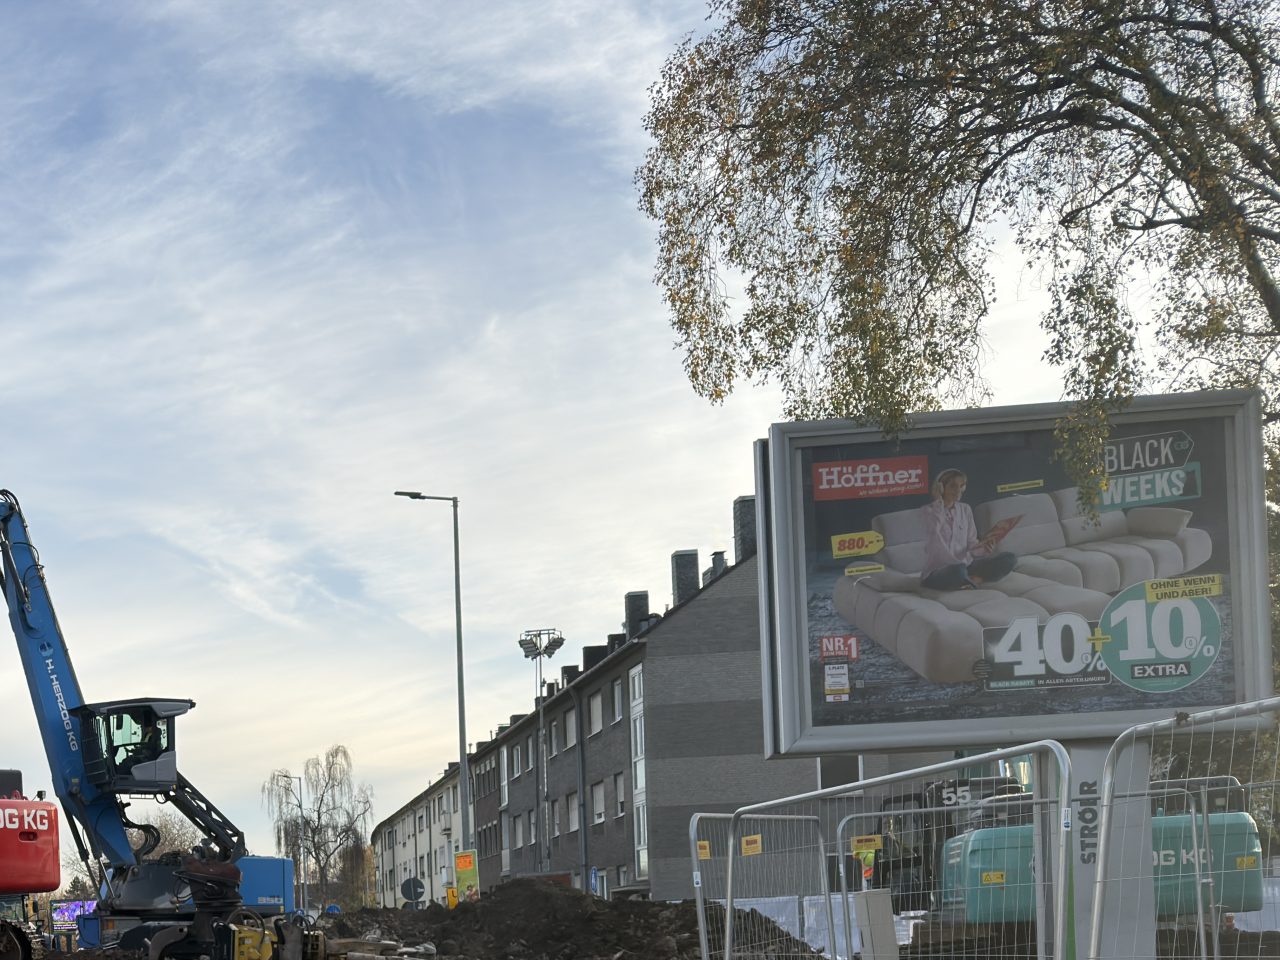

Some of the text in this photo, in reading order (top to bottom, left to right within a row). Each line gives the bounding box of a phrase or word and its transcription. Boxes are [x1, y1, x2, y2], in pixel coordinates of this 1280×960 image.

[1104, 437, 1175, 473] BLACK
[818, 464, 922, 489] Höffner
[1103, 470, 1186, 505] WEEKS
[1150, 576, 1215, 590] OHNE WENN
[1156, 587, 1212, 600] UND ABER!
[1134, 664, 1188, 677] EXTRA
[45, 659, 79, 751] H. HERZOG KG
[942, 786, 972, 805] 55
[23, 809, 49, 831] KG
